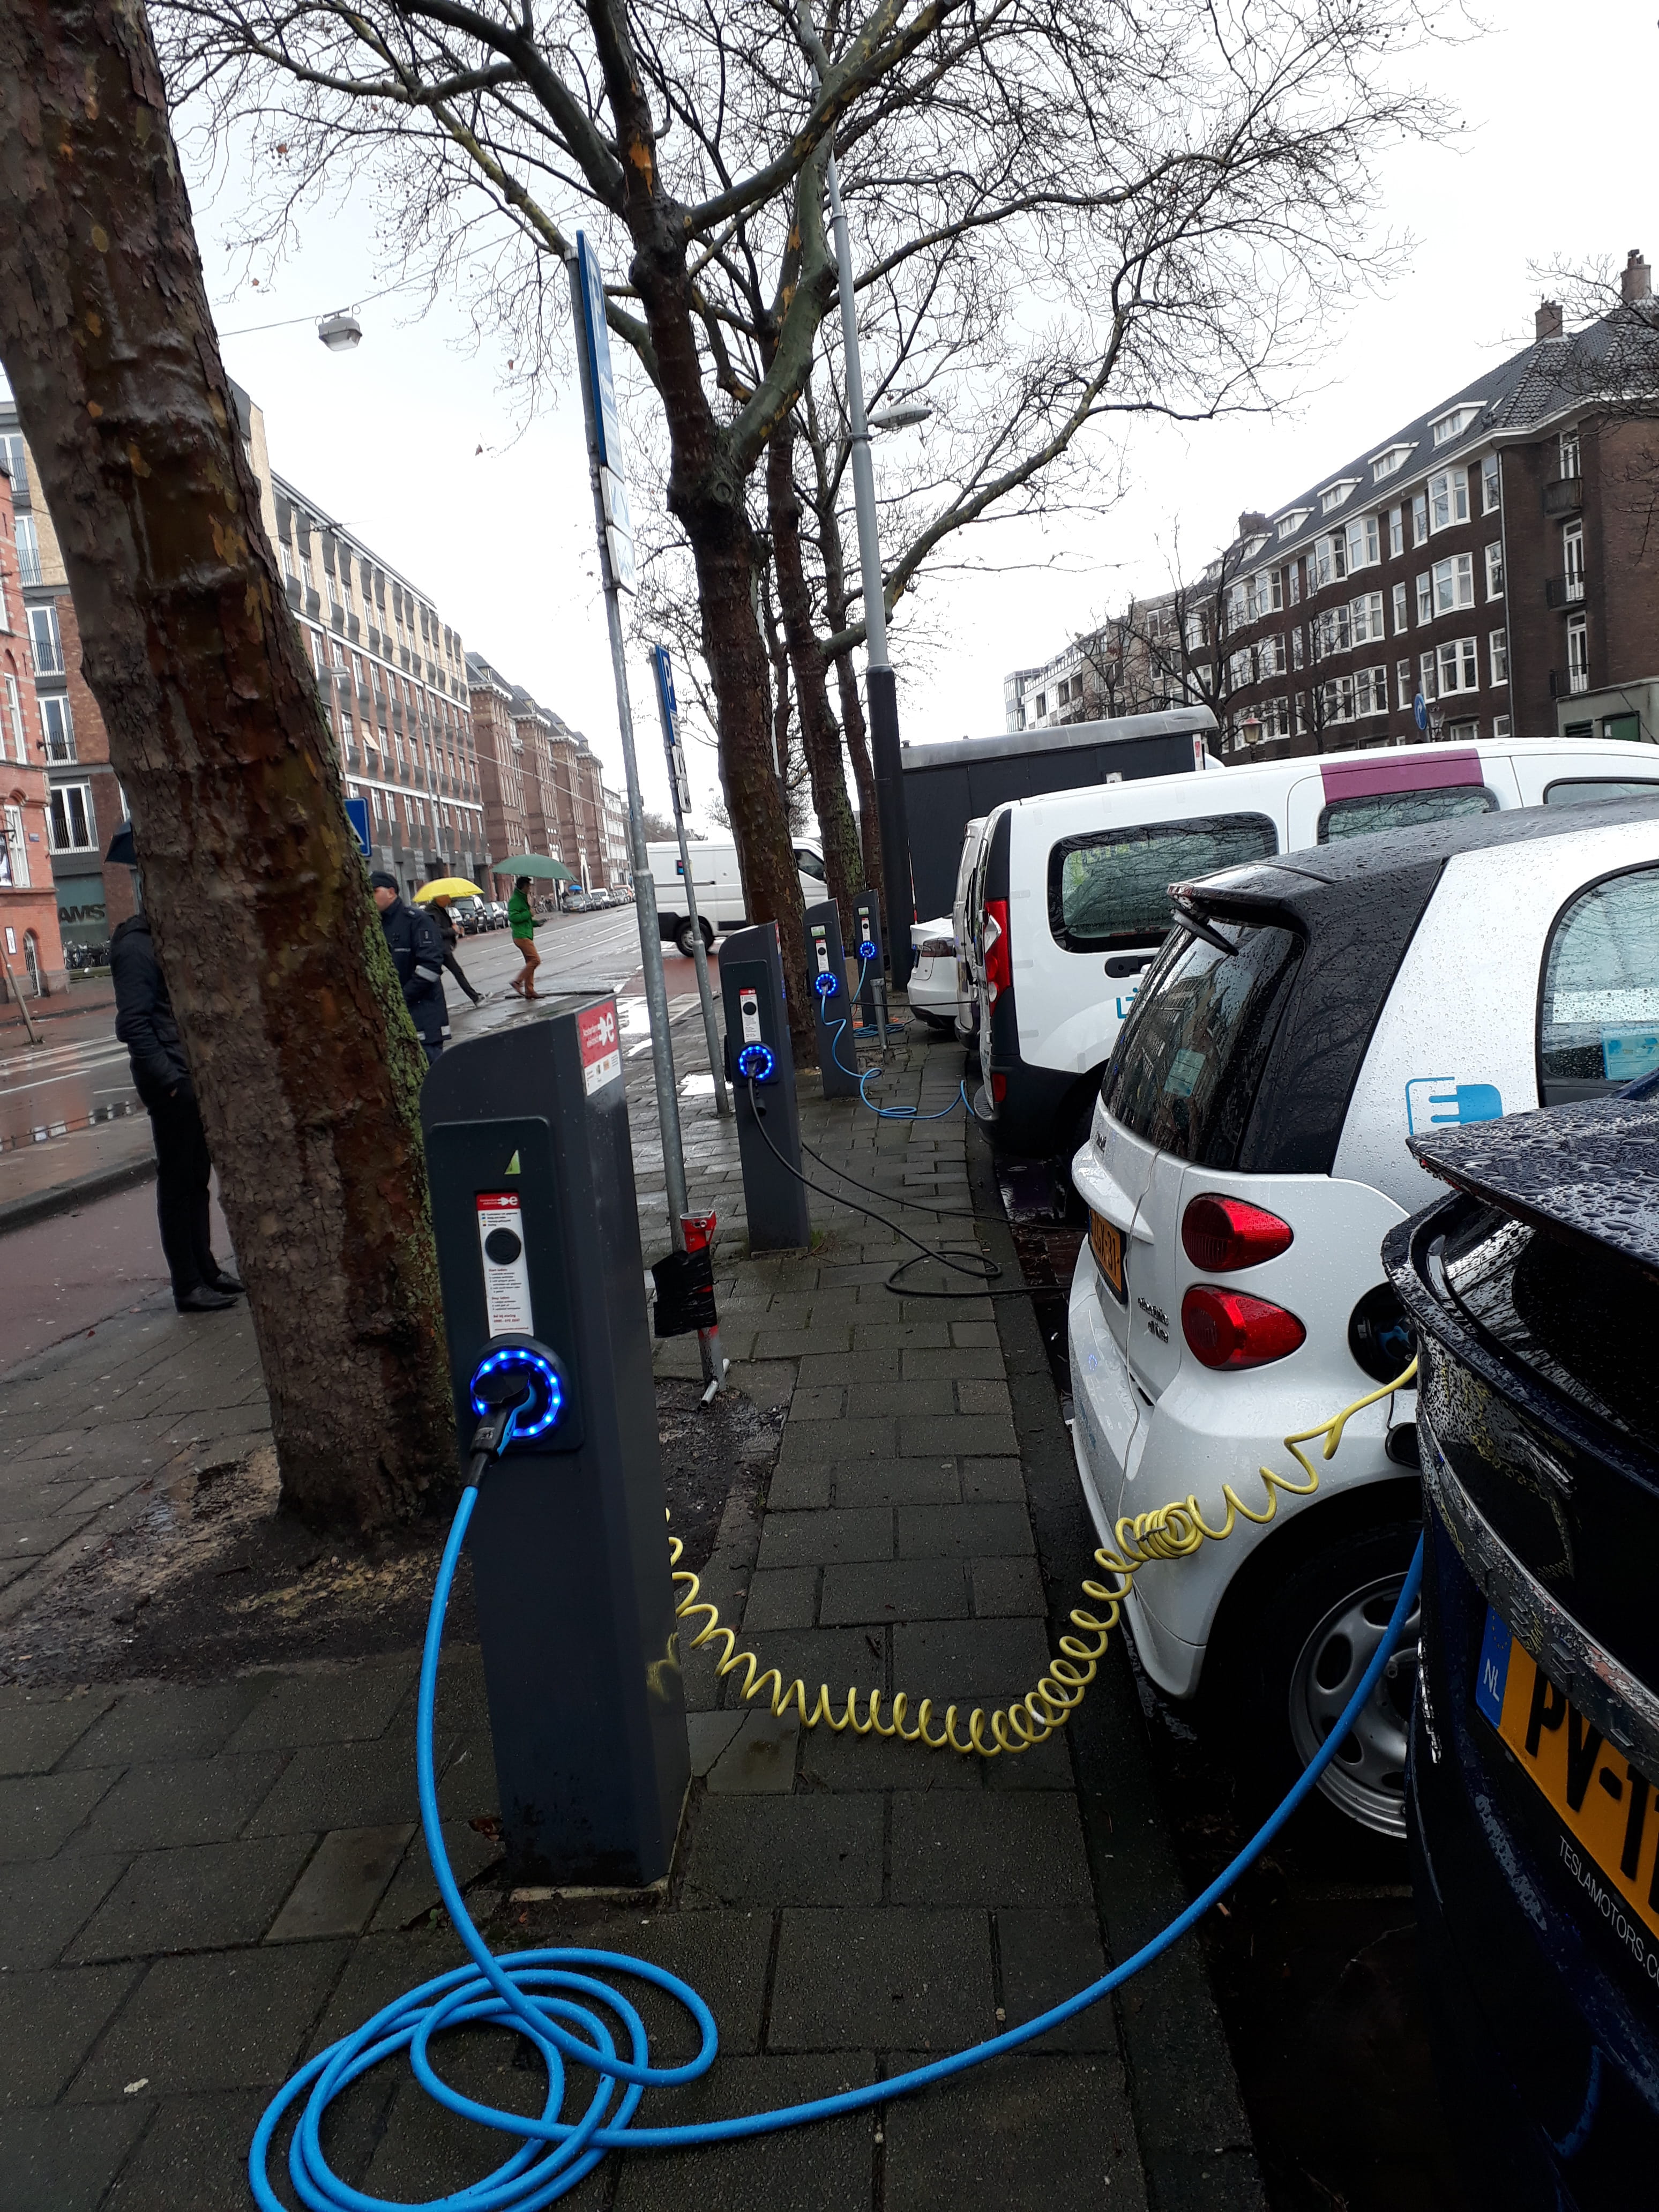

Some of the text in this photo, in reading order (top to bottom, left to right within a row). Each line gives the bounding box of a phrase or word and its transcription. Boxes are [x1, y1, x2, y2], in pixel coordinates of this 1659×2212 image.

[662, 655, 672, 704] P
[1483, 1658, 1500, 1703] NL
[1559, 1835, 1659, 1988] TESLAMOTORS.C
